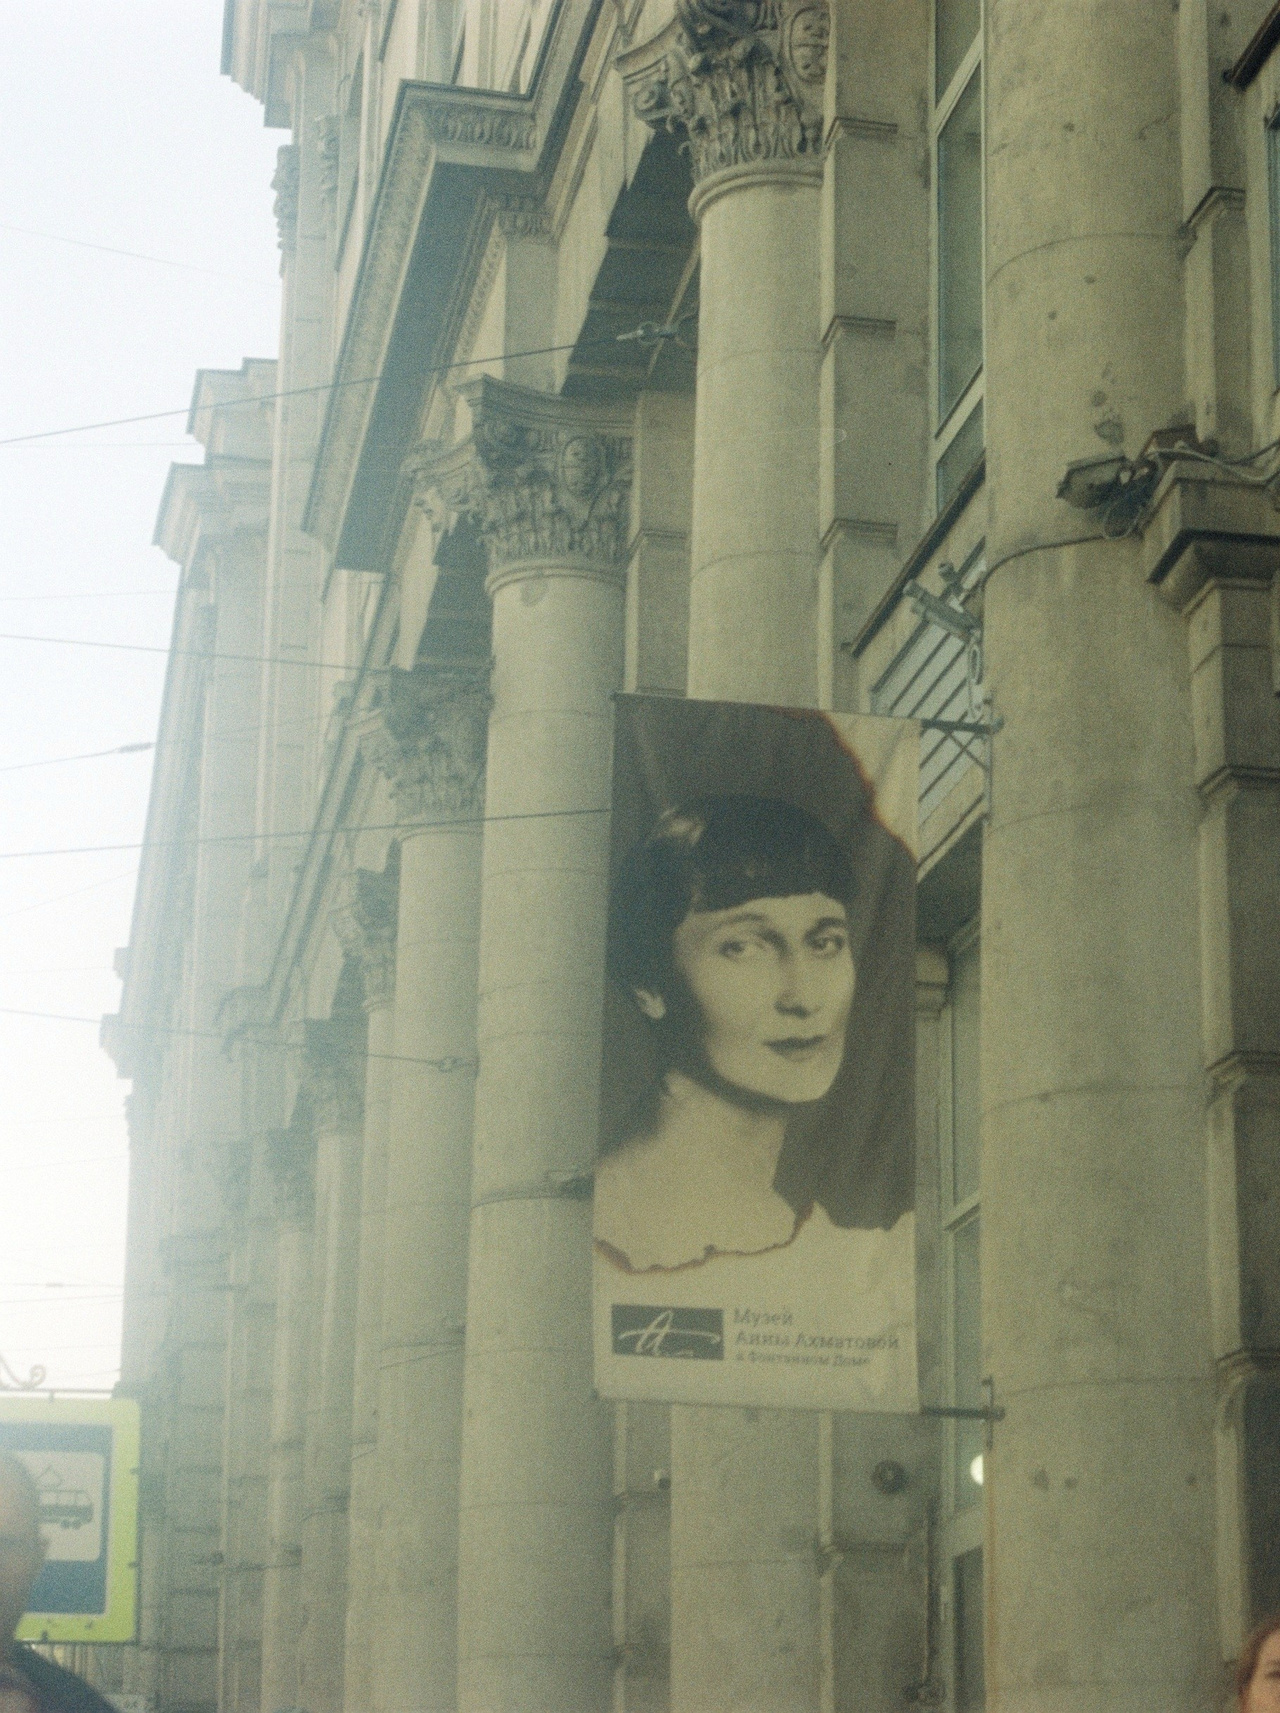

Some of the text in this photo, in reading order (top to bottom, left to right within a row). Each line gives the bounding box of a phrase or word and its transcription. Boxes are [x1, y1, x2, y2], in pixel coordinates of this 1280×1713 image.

[733, 1306, 793, 1327] Музей
[735, 1330, 898, 1350] Анны Ахматовой
